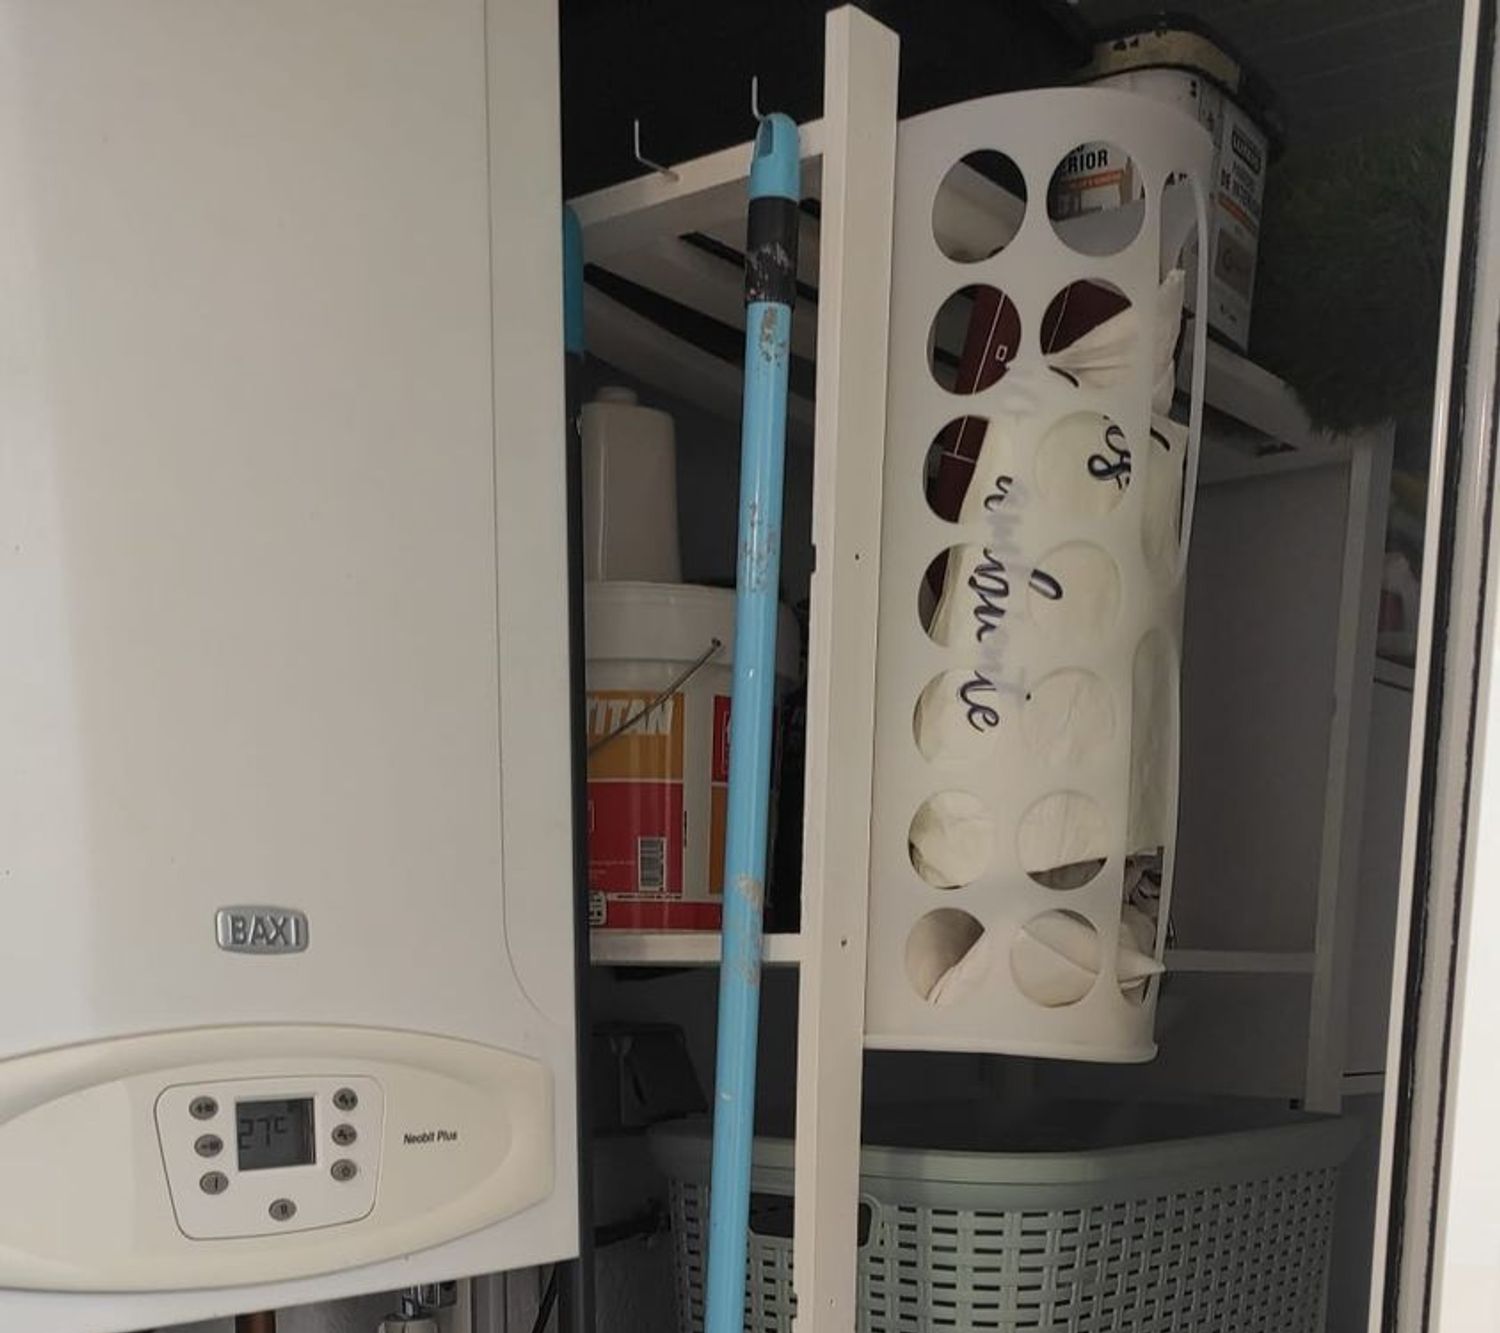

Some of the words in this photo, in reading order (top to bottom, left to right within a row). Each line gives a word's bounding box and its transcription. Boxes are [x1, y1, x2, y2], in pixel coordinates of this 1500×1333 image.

[227, 914, 300, 946] BAXI
[403, 1131, 435, 1145] Neobit
[437, 1129, 458, 1142] Plus
